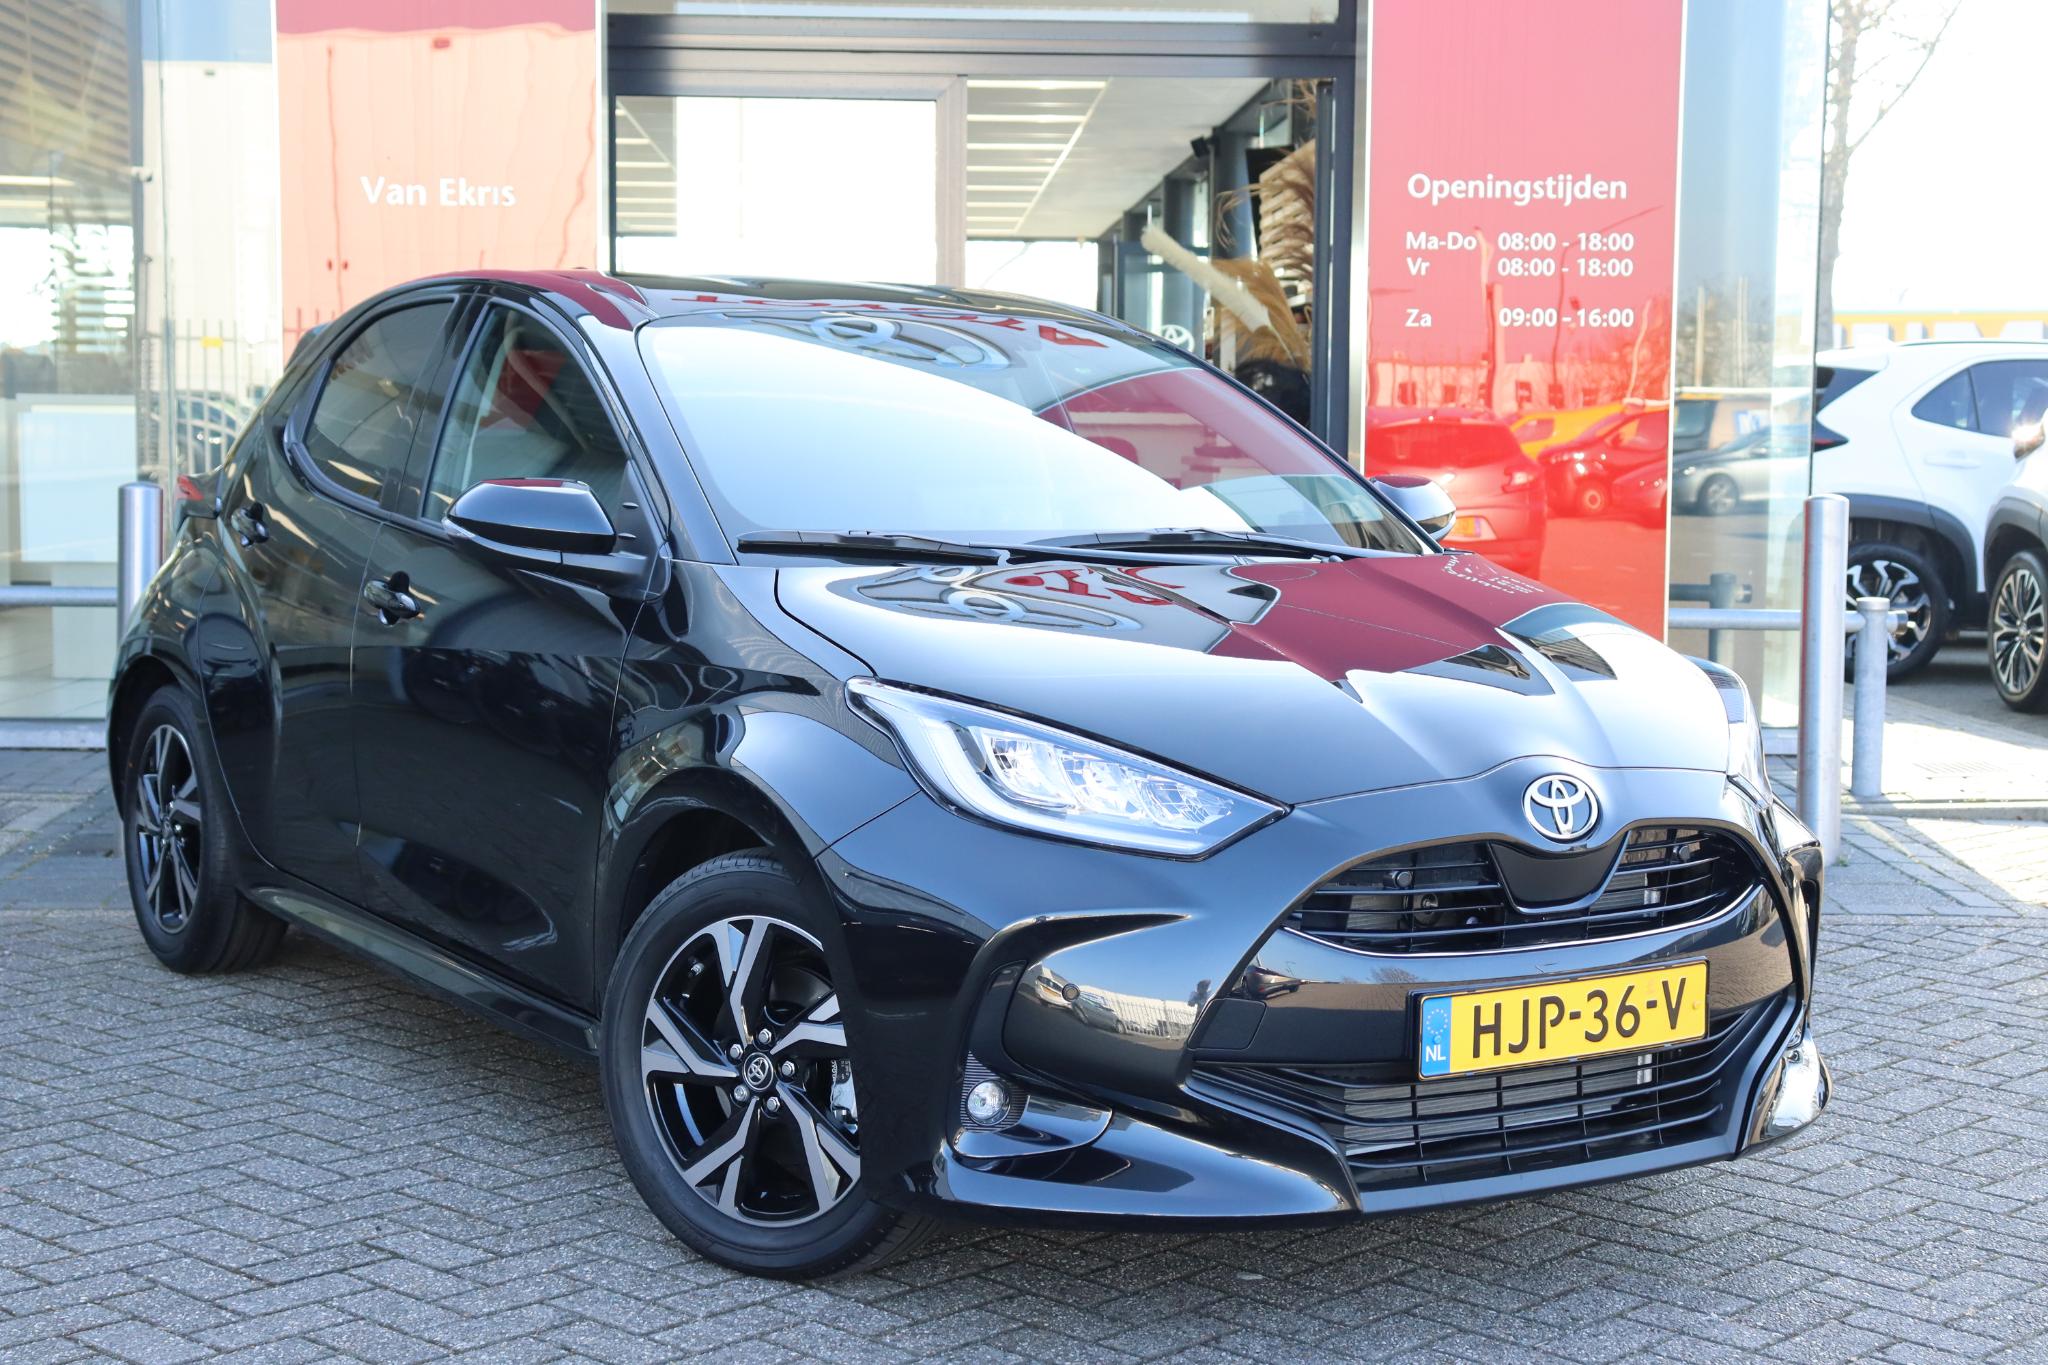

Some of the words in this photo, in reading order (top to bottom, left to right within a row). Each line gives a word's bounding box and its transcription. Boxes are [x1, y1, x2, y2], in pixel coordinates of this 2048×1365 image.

[359, 175, 427, 206] Van
[439, 177, 517, 207] Ekris
[1407, 173, 1627, 206] Openingstijden
[1405, 231, 1477, 250] Ma-Do
[1497, 232, 1556, 251] 08:00
[1577, 232, 1634, 251] 18:00
[1406, 257, 1430, 276] Vr
[1497, 258, 1556, 277] 08:00
[1577, 258, 1634, 277] 18:00
[1405, 308, 1432, 327] Za
[1499, 308, 1557, 327] 09:00
[1577, 308, 1634, 327] 16:00
[1472, 977, 1687, 1059] HJP-36-V
[1425, 1044, 1447, 1063] NL
